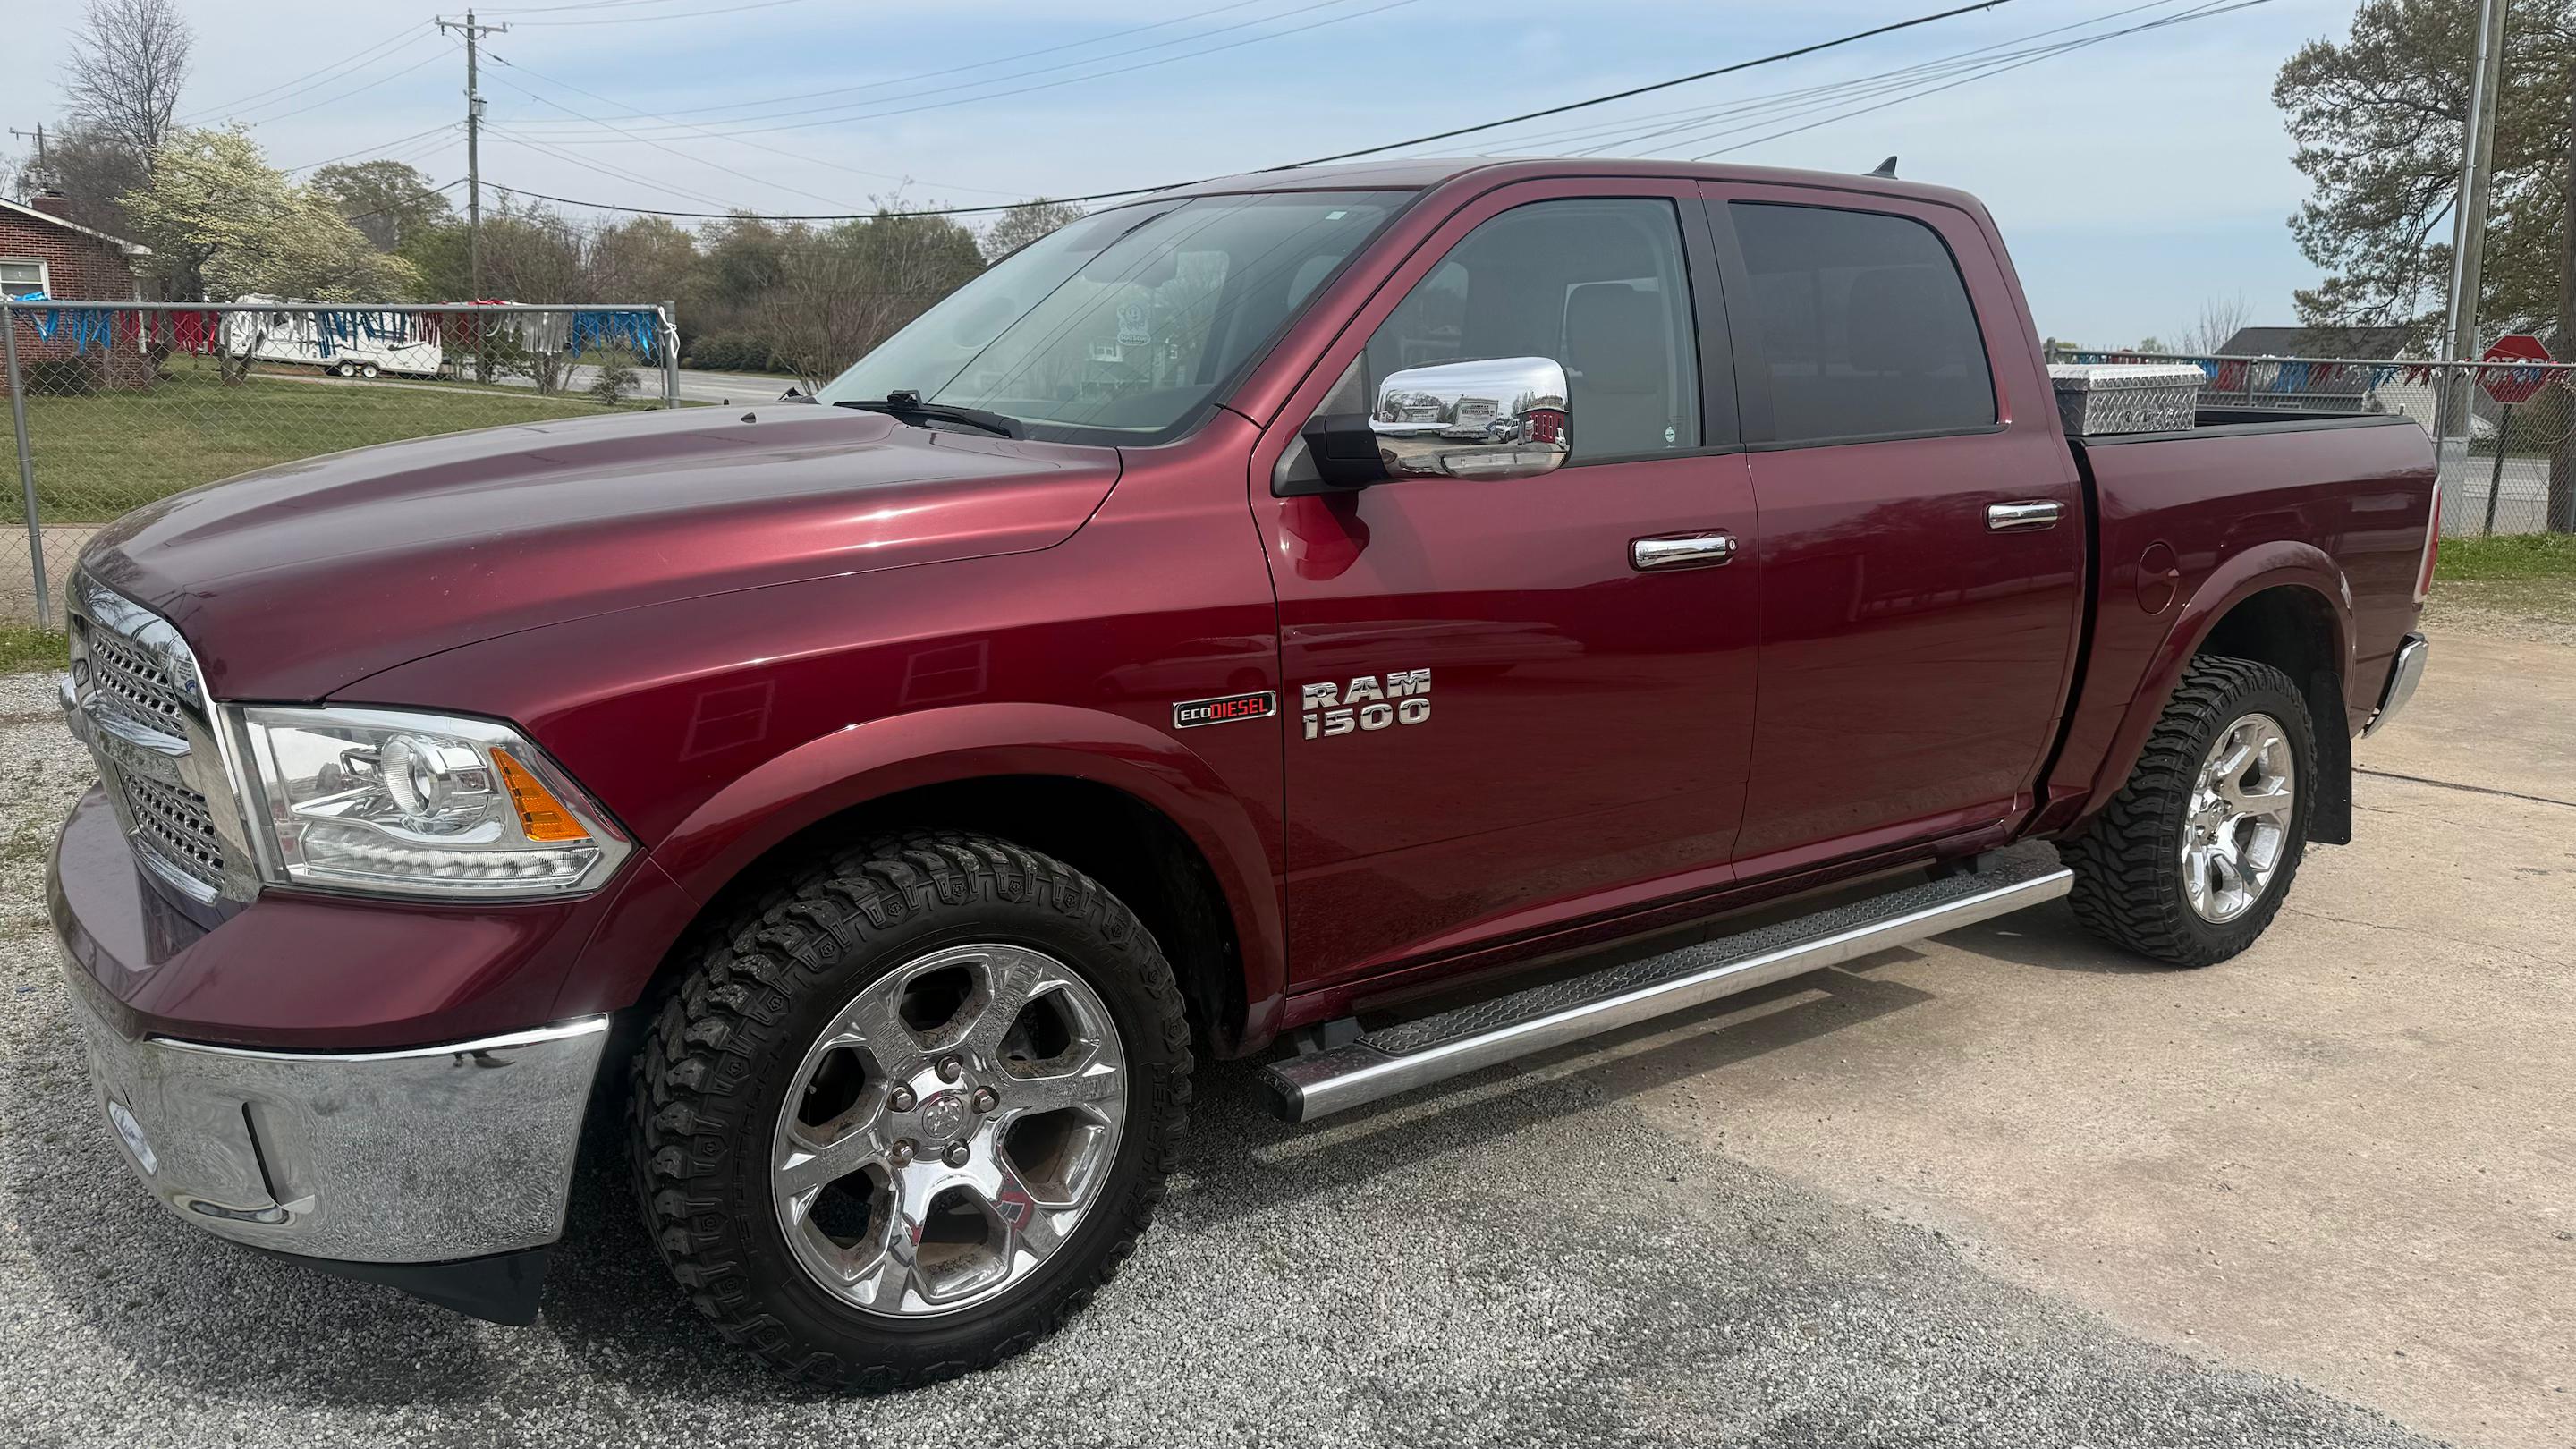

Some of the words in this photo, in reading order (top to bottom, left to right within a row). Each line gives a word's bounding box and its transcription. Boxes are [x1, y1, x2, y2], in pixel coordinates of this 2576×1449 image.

[1181, 699, 1268, 720] ECODIESEL
[1302, 668, 1431, 710] RAM
[1302, 698, 1431, 740] 1500
